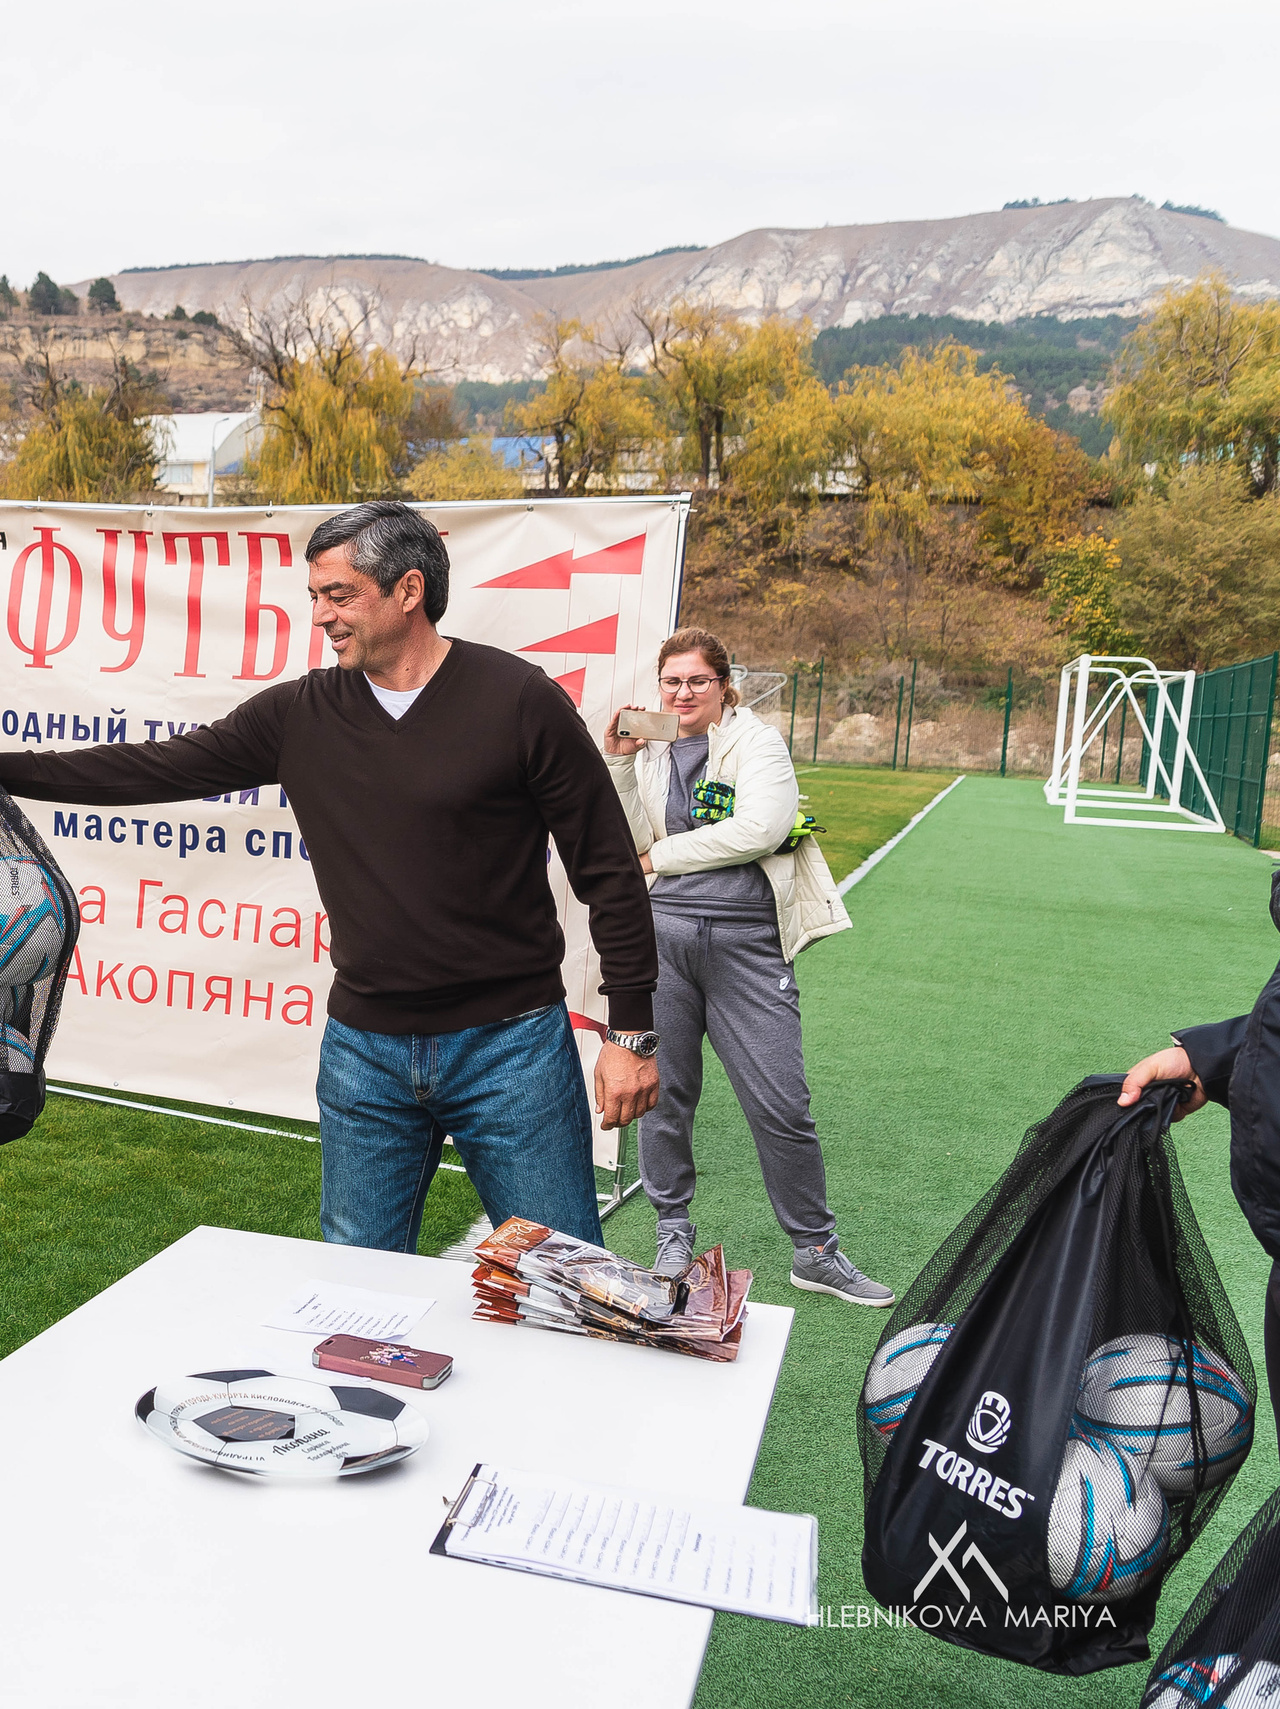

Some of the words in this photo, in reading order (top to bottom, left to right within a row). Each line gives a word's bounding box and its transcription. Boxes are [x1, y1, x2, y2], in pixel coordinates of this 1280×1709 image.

[7, 527, 324, 681] ФУТБ
[53, 810, 226, 859] мастера
[66, 944, 313, 1027] Акопяна
